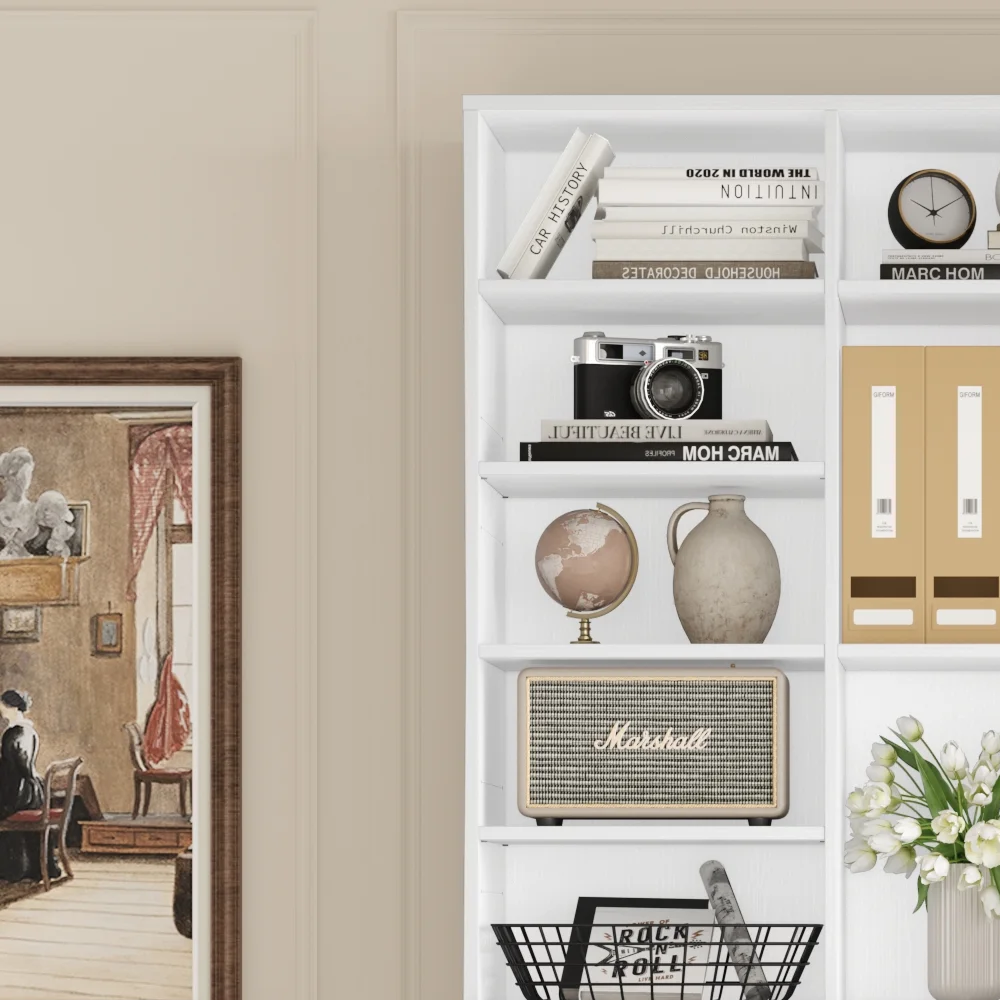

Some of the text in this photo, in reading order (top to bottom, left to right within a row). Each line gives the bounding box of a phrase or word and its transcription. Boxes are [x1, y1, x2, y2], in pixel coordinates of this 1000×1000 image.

[686, 169, 811, 178] THE WORLD IN 2020
[721, 184, 818, 199] INTUITION
[530, 162, 588, 255] CAR HISTORY
[891, 267, 985, 280] MARC HOM
[593, 720, 711, 750] Marshall
[619, 924, 687, 944] ROCK
[611, 955, 683, 978] ROLL
